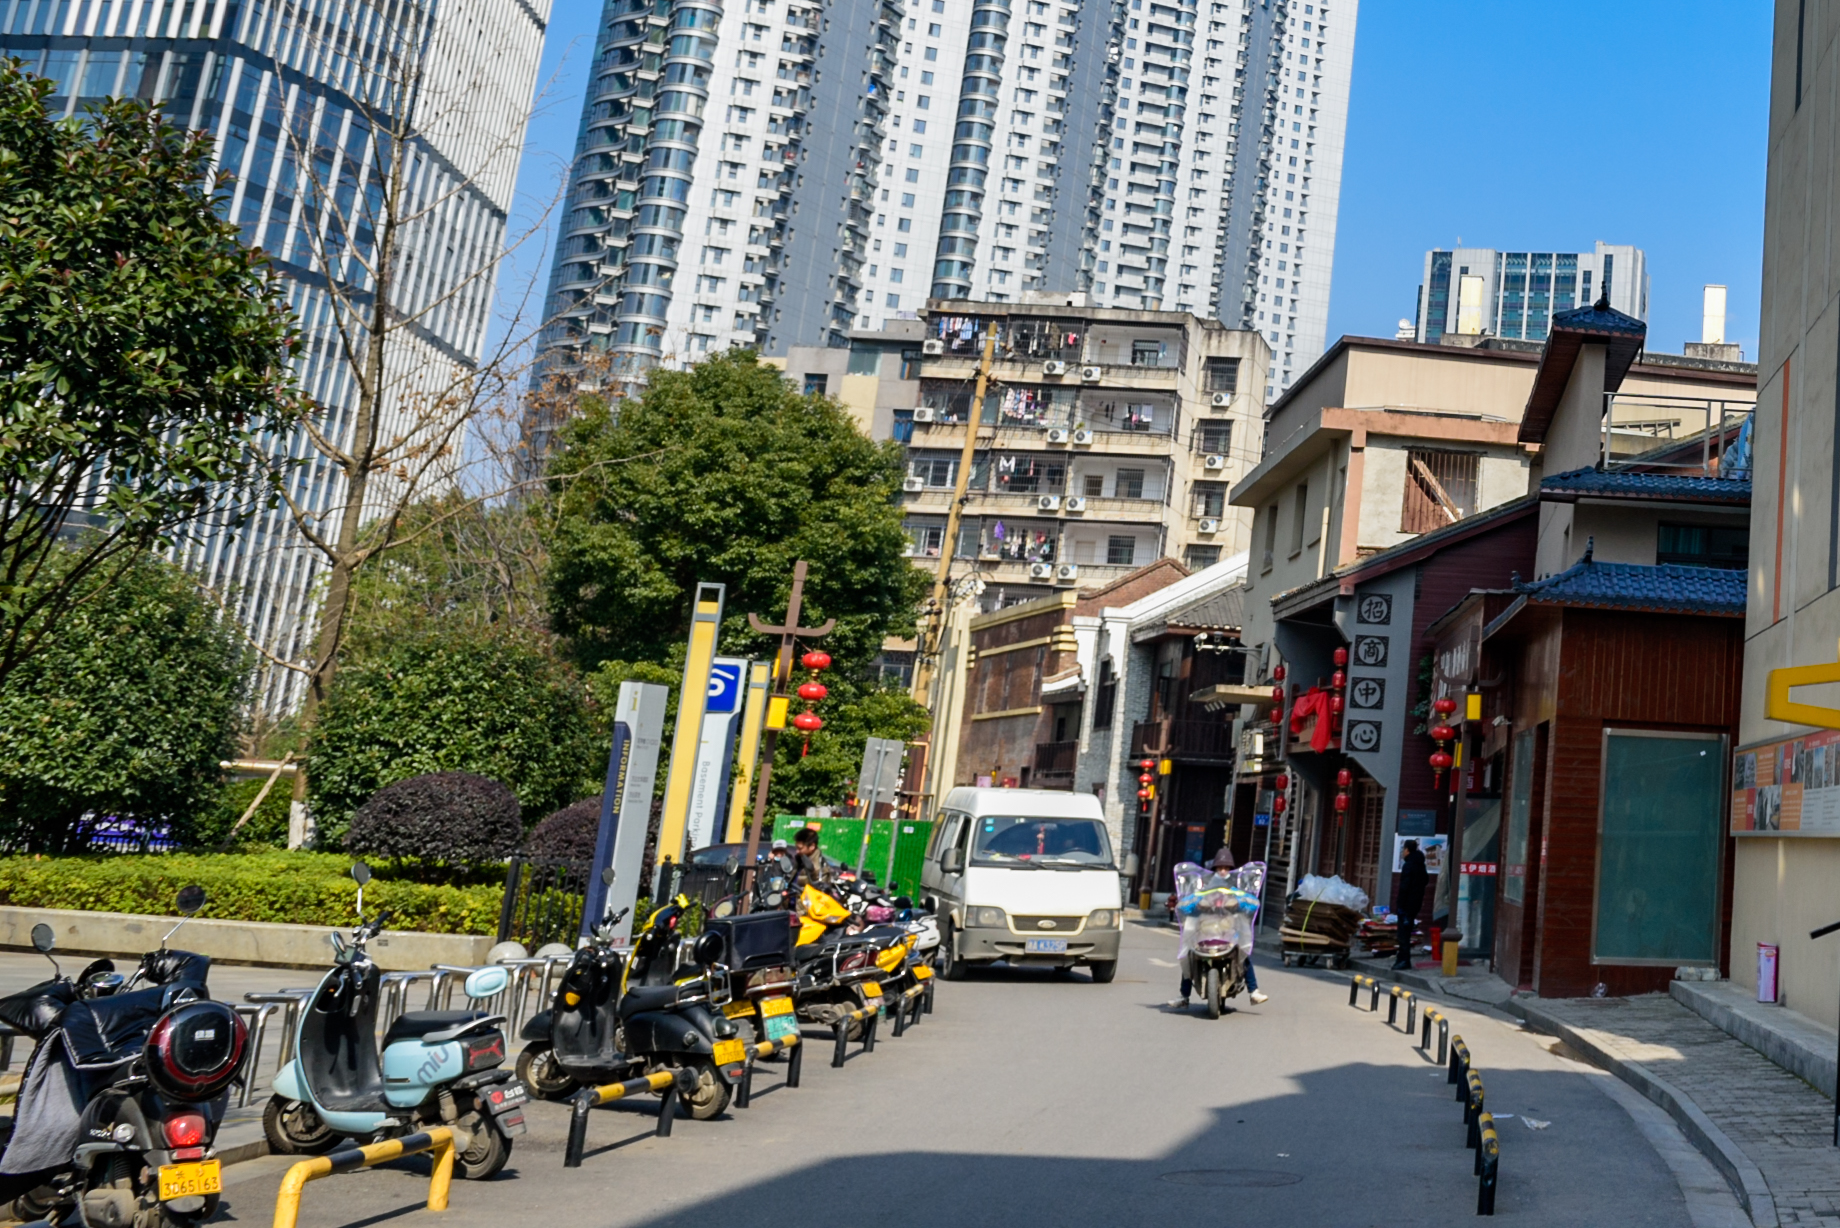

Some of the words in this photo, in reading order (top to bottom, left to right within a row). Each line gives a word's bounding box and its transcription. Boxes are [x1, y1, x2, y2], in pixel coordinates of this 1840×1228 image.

[1352, 598, 1387, 747] 招商中心
[613, 739, 630, 814] INFORMATION
[697, 760, 711, 810] Basement
